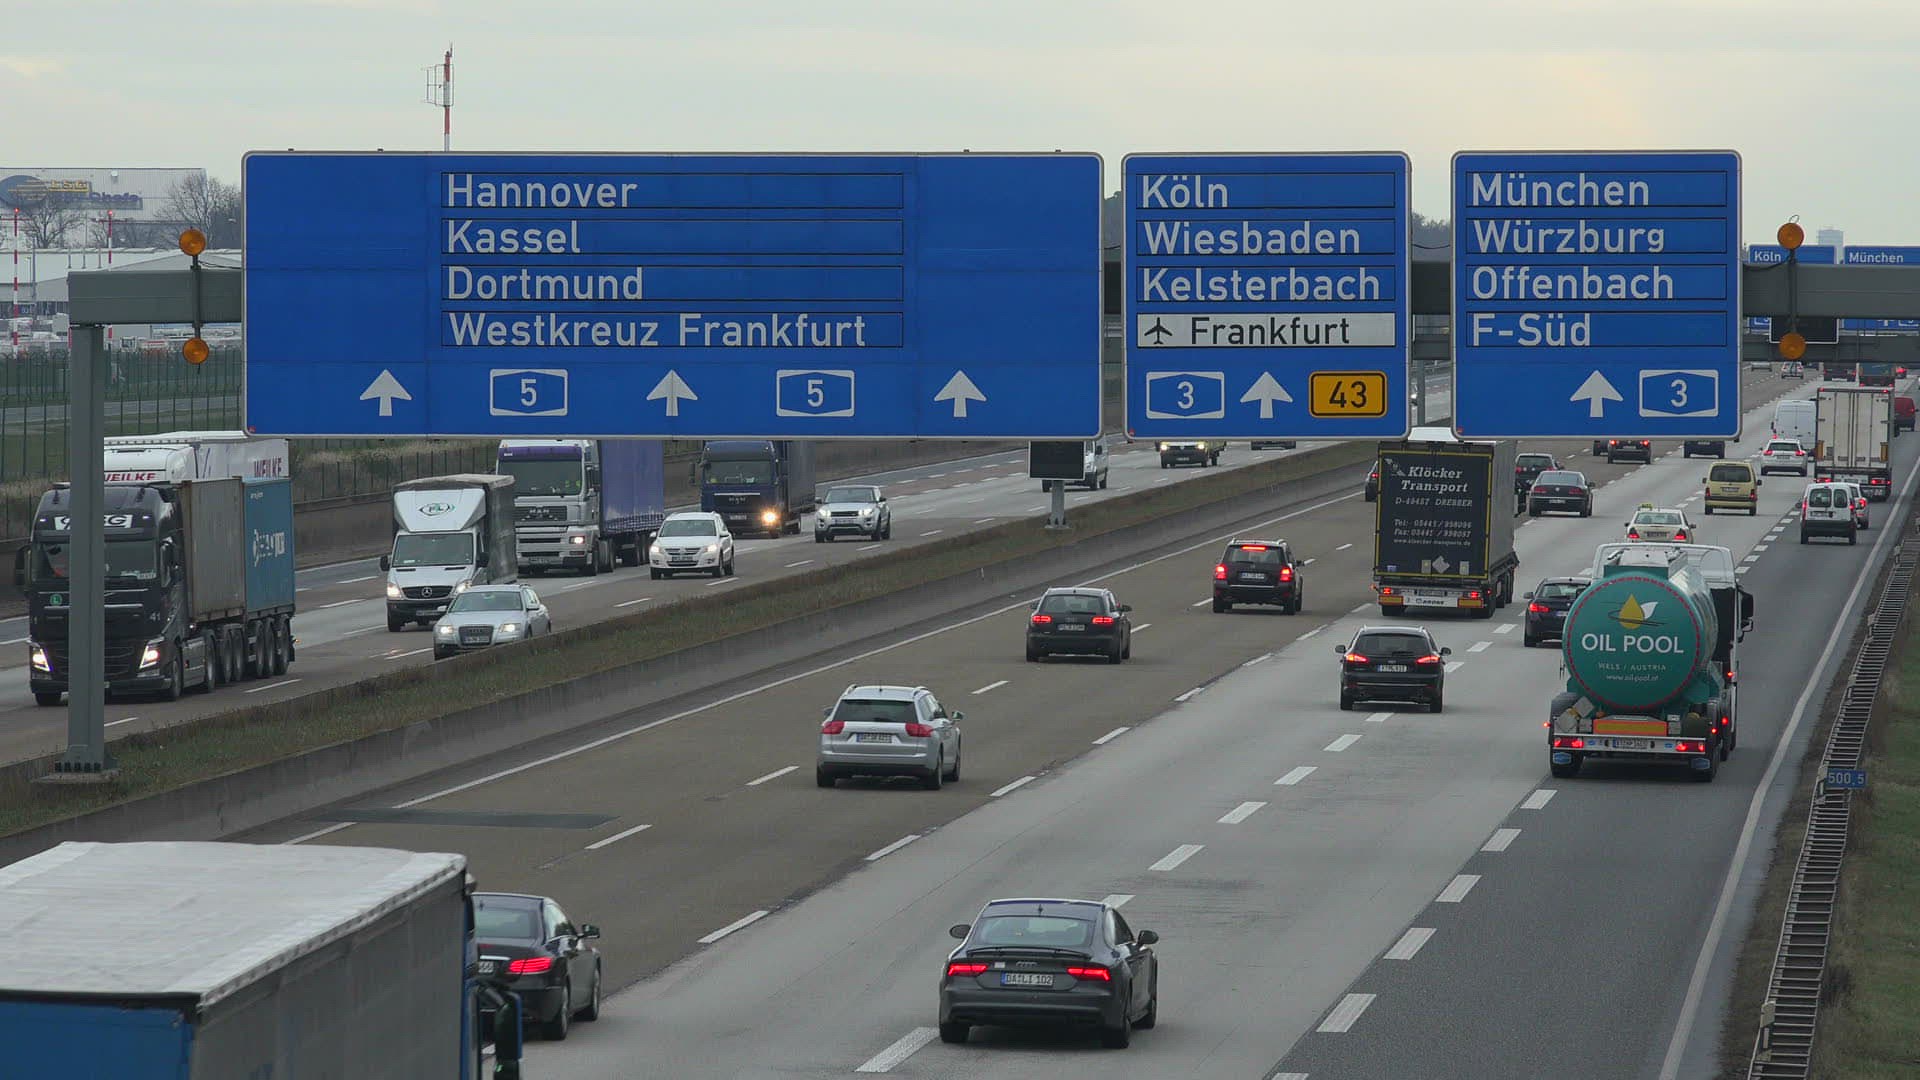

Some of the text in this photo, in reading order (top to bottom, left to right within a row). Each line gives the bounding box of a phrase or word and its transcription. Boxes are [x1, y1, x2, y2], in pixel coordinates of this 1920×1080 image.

[448, 173, 638, 207] Hannover
[1142, 174, 1229, 208] Köln
[1472, 172, 1650, 207] München
[447, 219, 581, 254] Kassel
[1143, 220, 1360, 254] Wiesbaden
[1473, 219, 1665, 253] Würzburg
[1754, 250, 1782, 263] Köln
[1848, 251, 1904, 264] München
[447, 266, 643, 300] Dortmund
[1143, 266, 1380, 301] Kelsterbach
[1472, 265, 1673, 300] Offenbach
[448, 312, 866, 347] Westkreuz Frankfurt
[1191, 316, 1350, 345] Frankfurt
[1472, 312, 1592, 347] F-Süd
[520, 378, 537, 407] 5
[806, 378, 823, 407] 5
[1177, 381, 1194, 409] 3
[1328, 380, 1368, 408] 43
[1670, 378, 1688, 408] 3
[1400, 480, 1468, 495] Transport
[1407, 466, 1464, 479] Klöcker
[1581, 633, 1684, 654] OIL POOL
[1629, 663, 1667, 672] AUSTRIA
